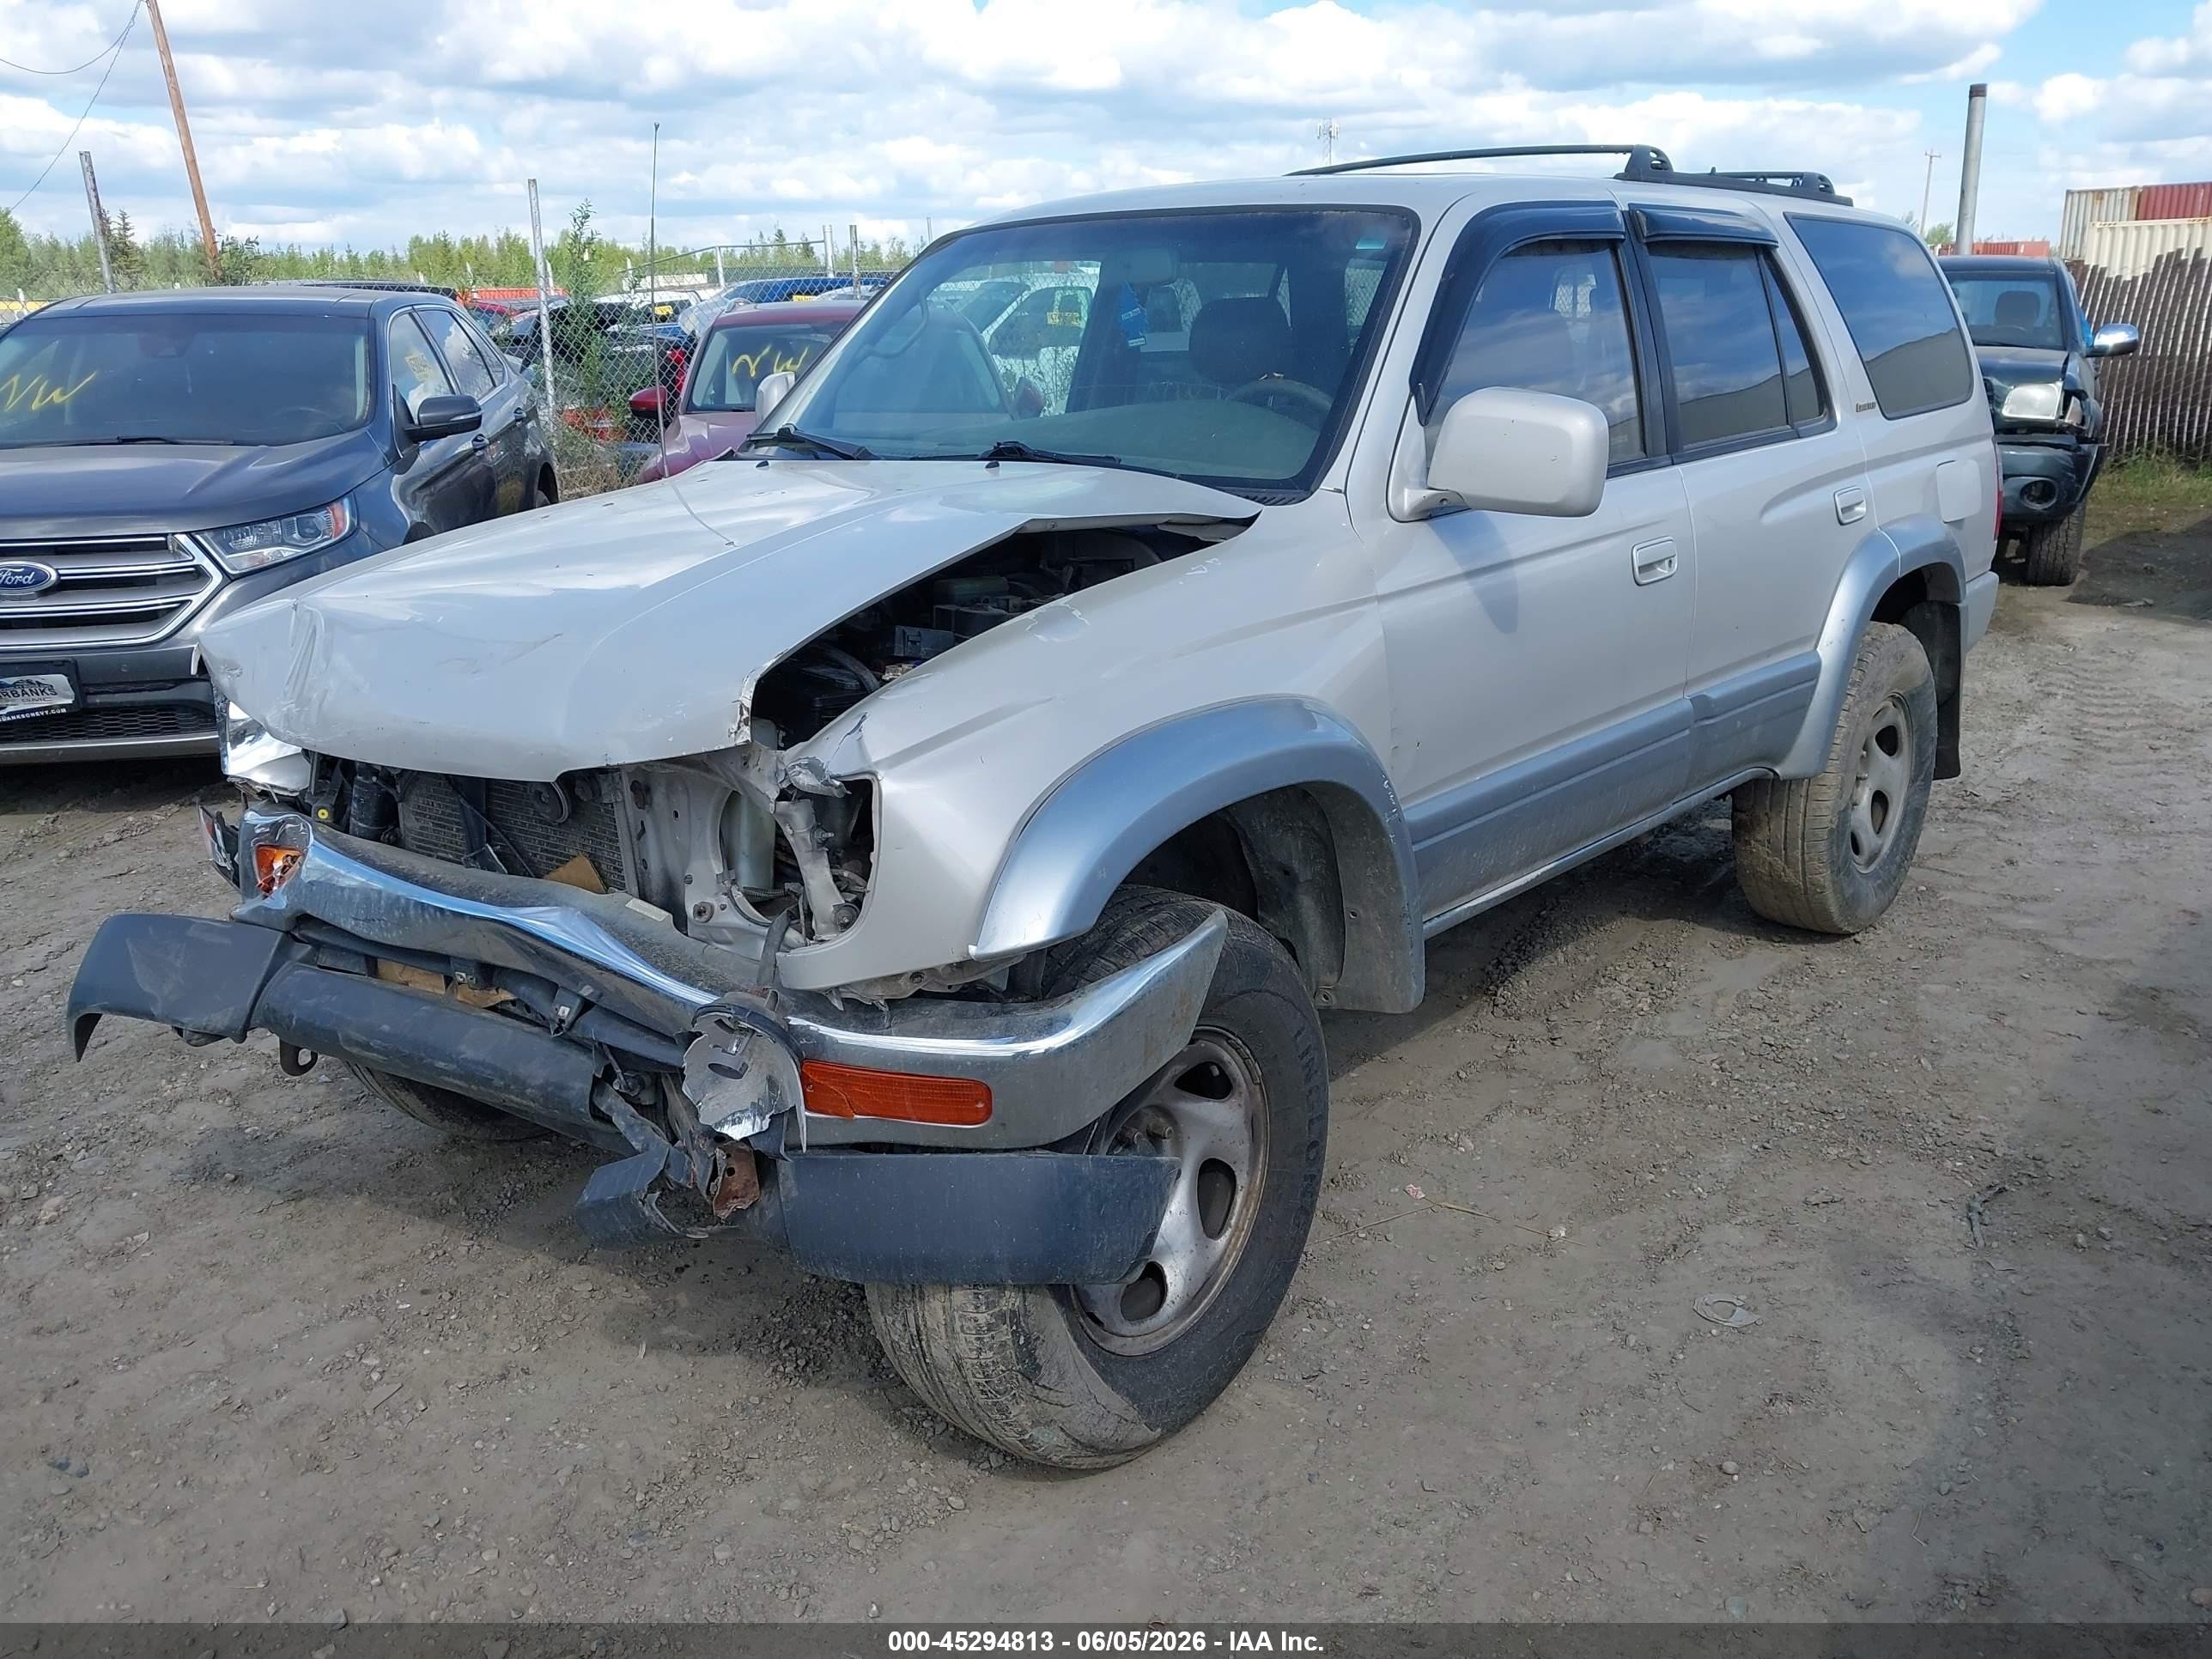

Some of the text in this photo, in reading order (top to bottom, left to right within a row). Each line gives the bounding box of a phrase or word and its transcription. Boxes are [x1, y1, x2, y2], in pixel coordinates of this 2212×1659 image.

[0, 568, 35, 585] Ford
[0, 687, 58, 699] RBANKS
[0, 708, 67, 721] BANKSCHEVY.COM
